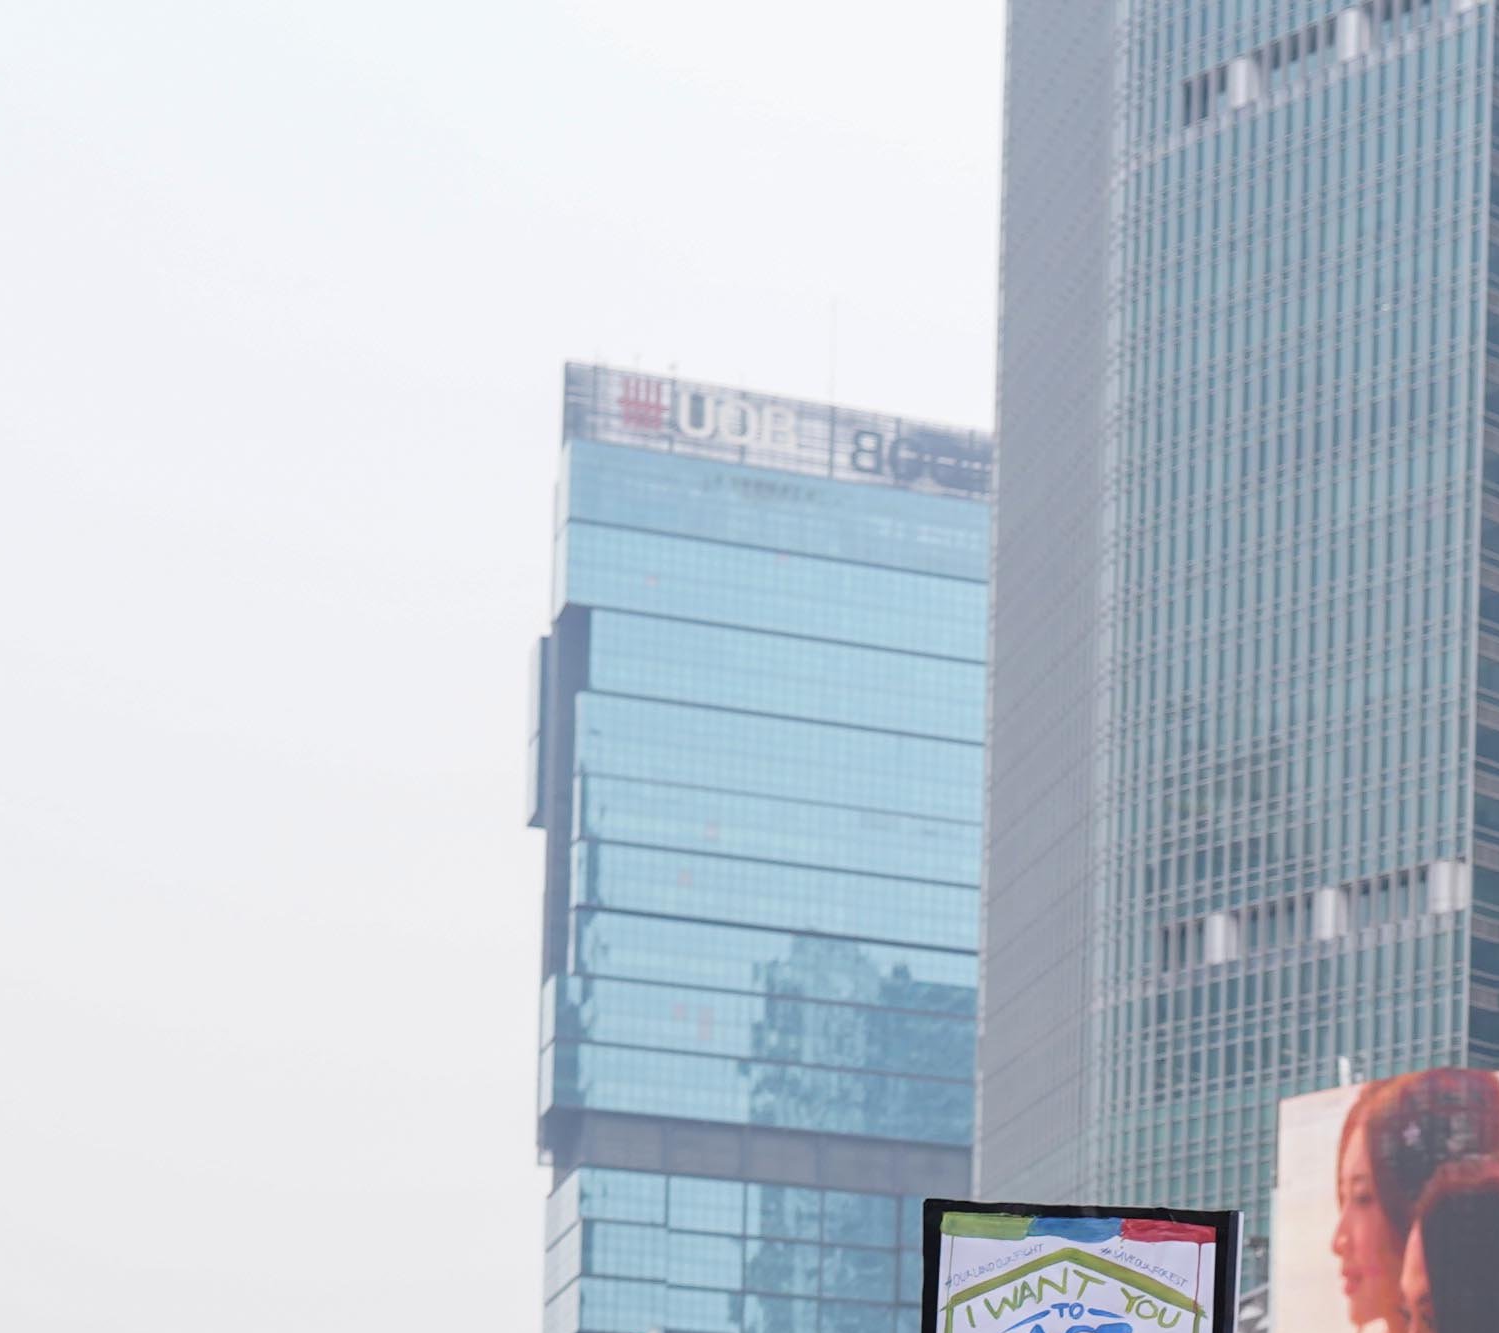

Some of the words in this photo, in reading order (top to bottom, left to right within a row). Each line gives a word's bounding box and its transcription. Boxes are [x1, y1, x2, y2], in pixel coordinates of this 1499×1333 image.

[676, 391, 799, 451] UOB
[966, 1305, 976, 1328] I
[984, 1267, 1106, 1319] WANT
[1121, 1287, 1181, 1328] YOU
[1051, 1302, 1085, 1320] TO
